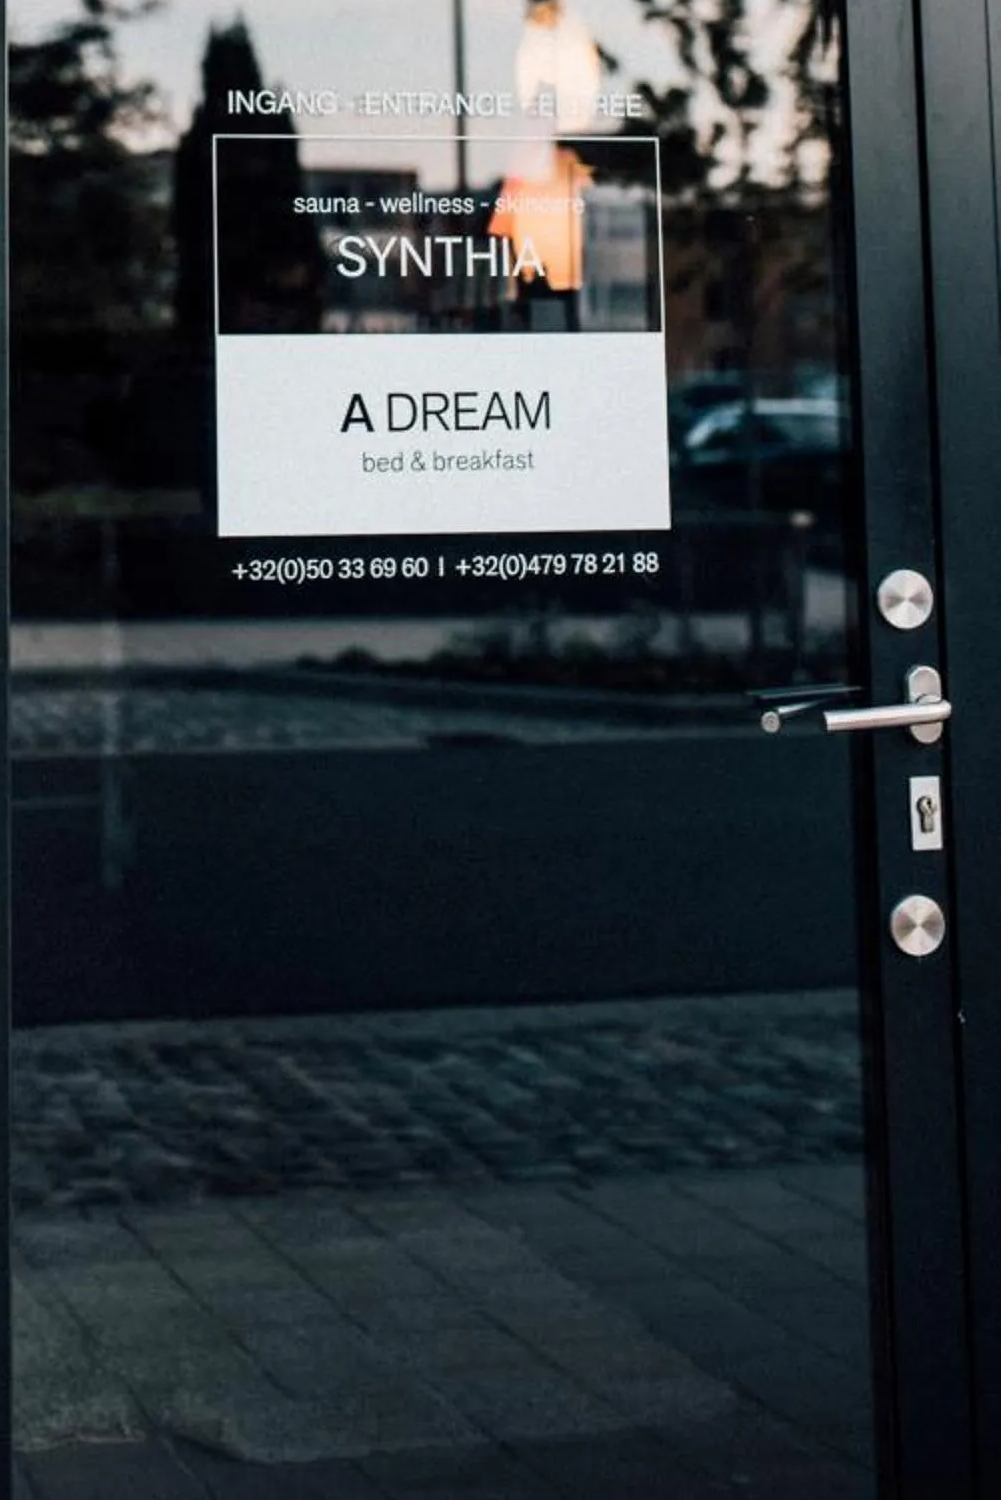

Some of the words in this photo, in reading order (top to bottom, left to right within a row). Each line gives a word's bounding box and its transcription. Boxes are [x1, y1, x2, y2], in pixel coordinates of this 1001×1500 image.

[227, 90, 338, 115] INGANG
[364, 91, 513, 117] ENTRANCE
[294, 196, 360, 214] sauna
[380, 194, 474, 214] wellness
[336, 235, 546, 278] SYNTHIA
[340, 394, 374, 433] A
[387, 391, 551, 432] DREAM
[361, 452, 404, 473] bed
[410, 452, 426, 472] &
[432, 449, 535, 472] breakfast
[231, 557, 334, 585] +32(0)50
[338, 559, 365, 579] 33
[369, 558, 396, 579] 69
[401, 557, 428, 578] 60
[455, 553, 566, 580] +32(0)479
[570, 553, 598, 574] 78
[601, 553, 625, 574] 21
[632, 552, 660, 573] 88
